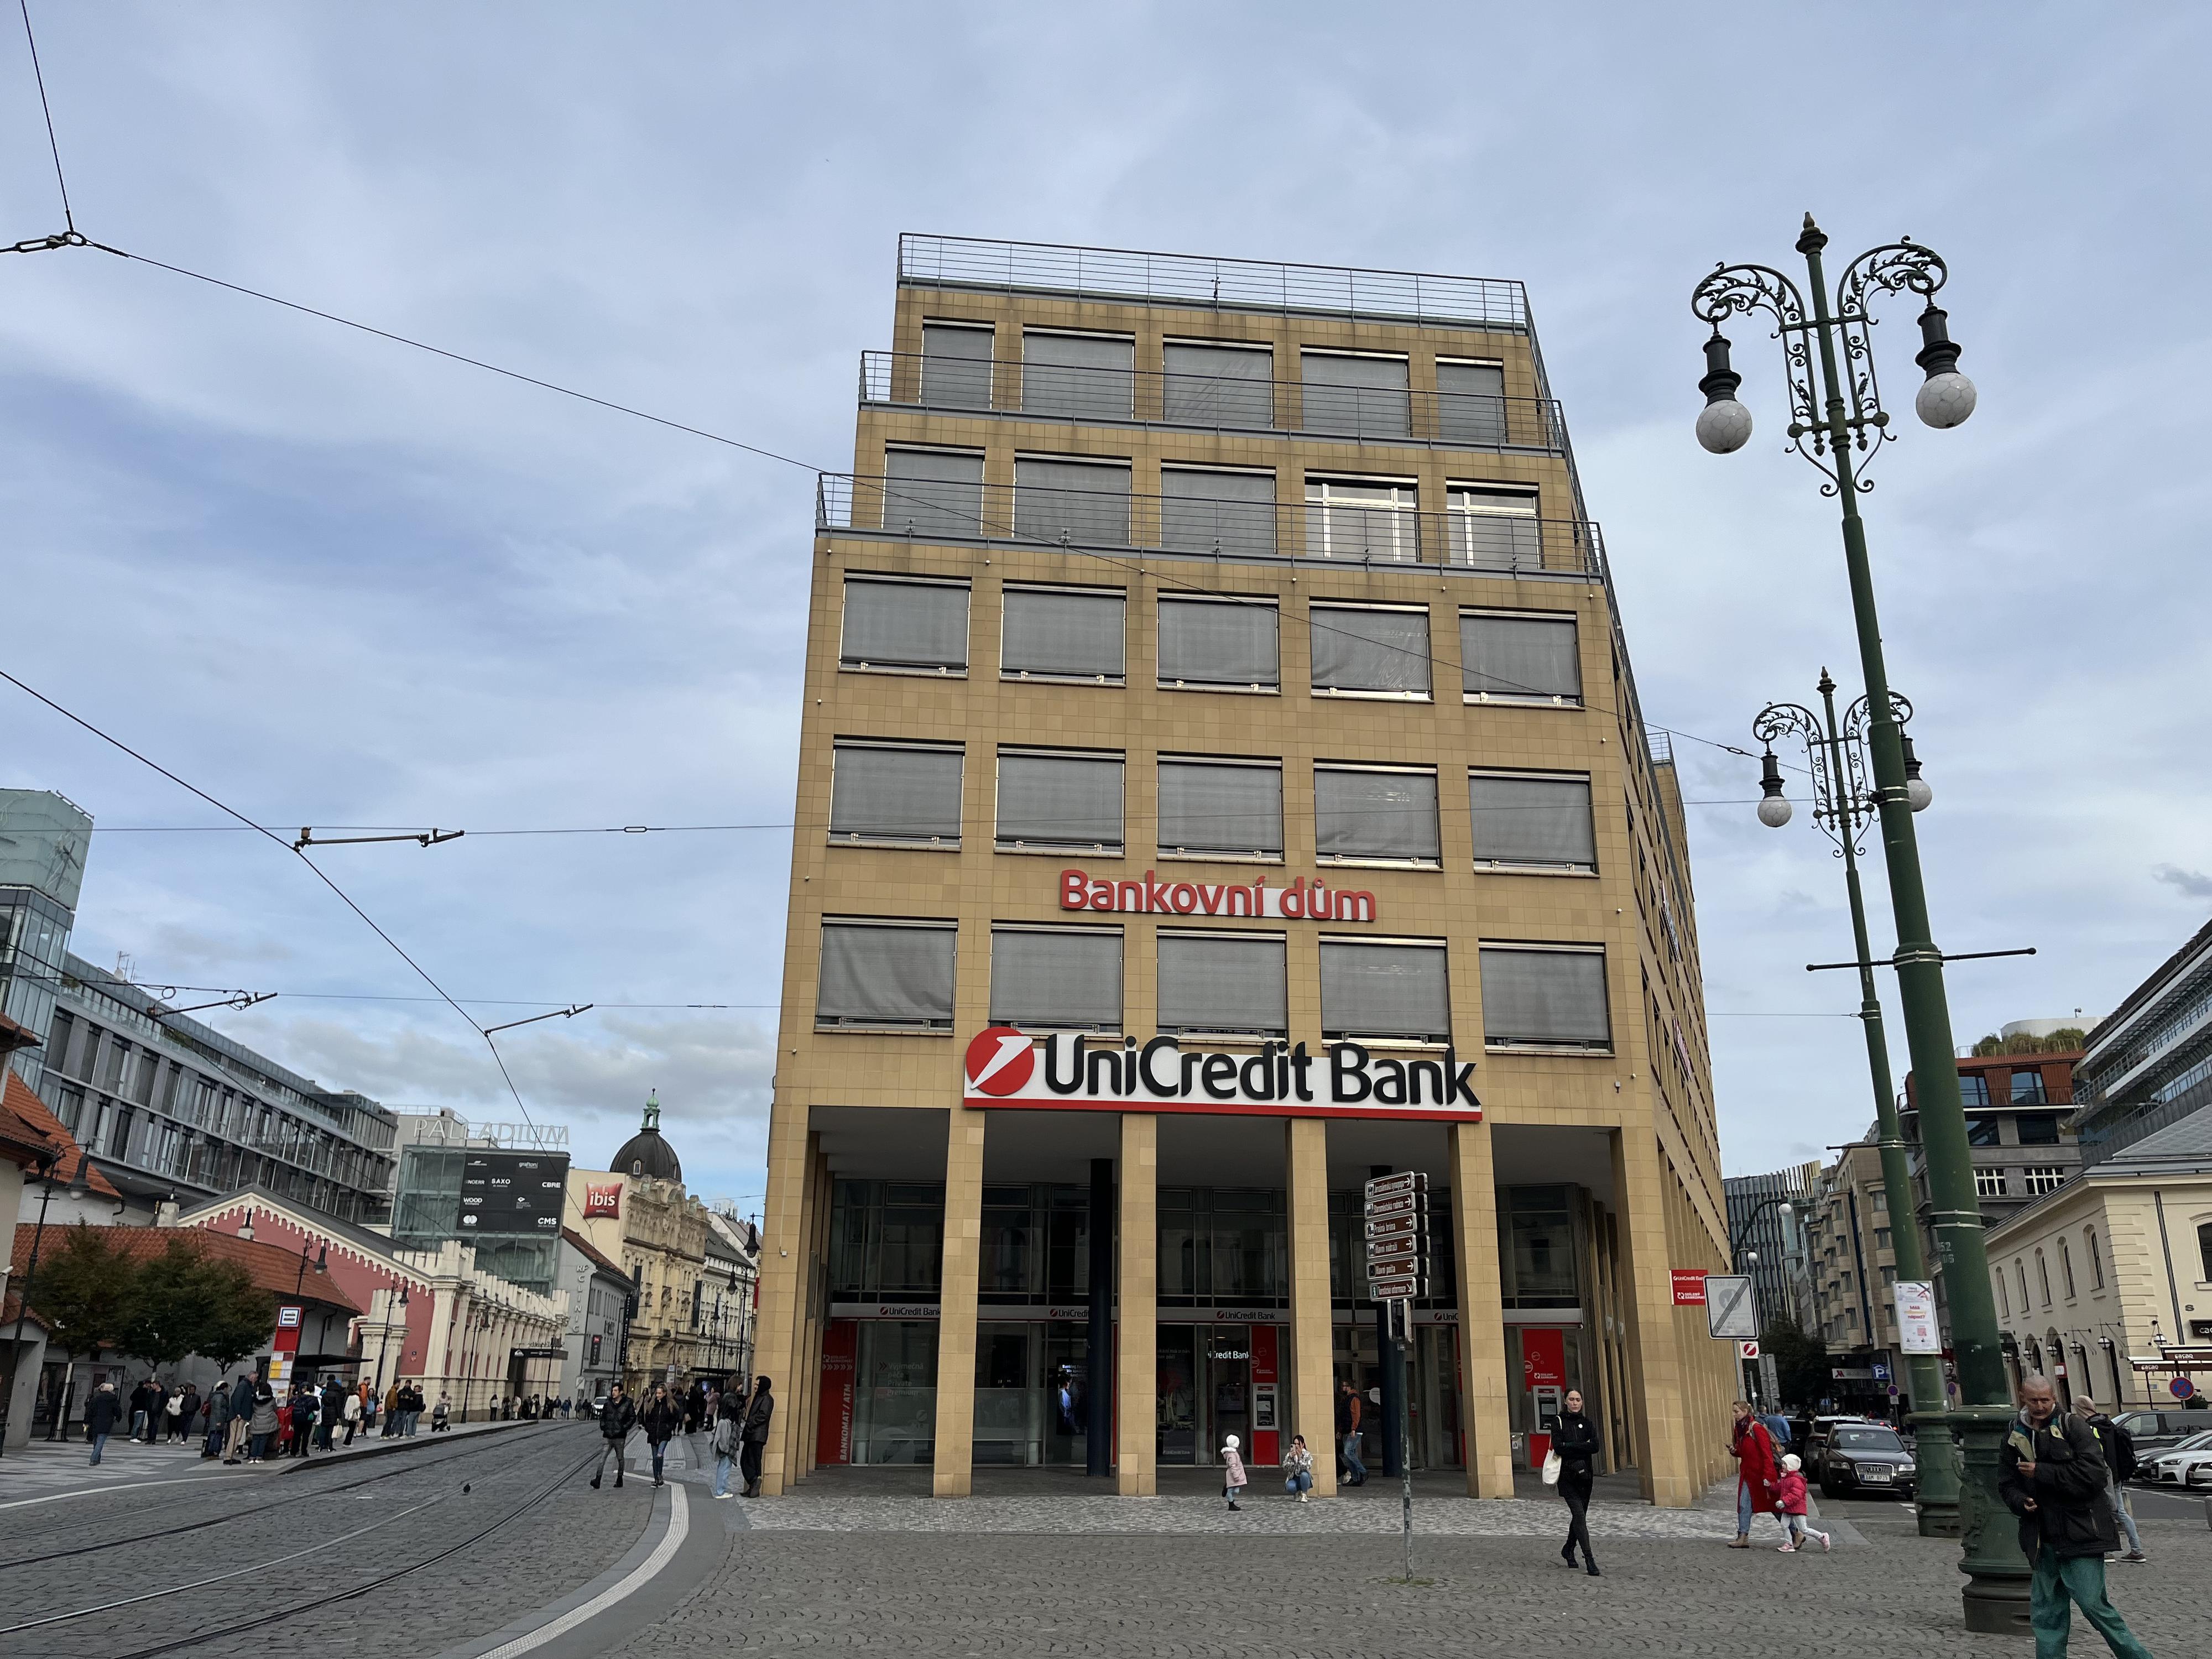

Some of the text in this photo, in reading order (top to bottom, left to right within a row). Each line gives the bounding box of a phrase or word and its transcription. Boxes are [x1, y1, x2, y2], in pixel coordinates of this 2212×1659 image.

[1061, 869, 1376, 920] Bankovní dům
[1044, 1033, 1481, 1106] UniCredit Bank
[414, 1119, 569, 1145] PALLADIUM
[589, 1191, 615, 1206] ibis
[889, 1307, 941, 1316] UniCredit Bank
[1058, 1309, 1089, 1317] UniCredi
[1875, 1368, 1885, 1378] P
[839, 1411, 850, 1460] BANKOMAT
